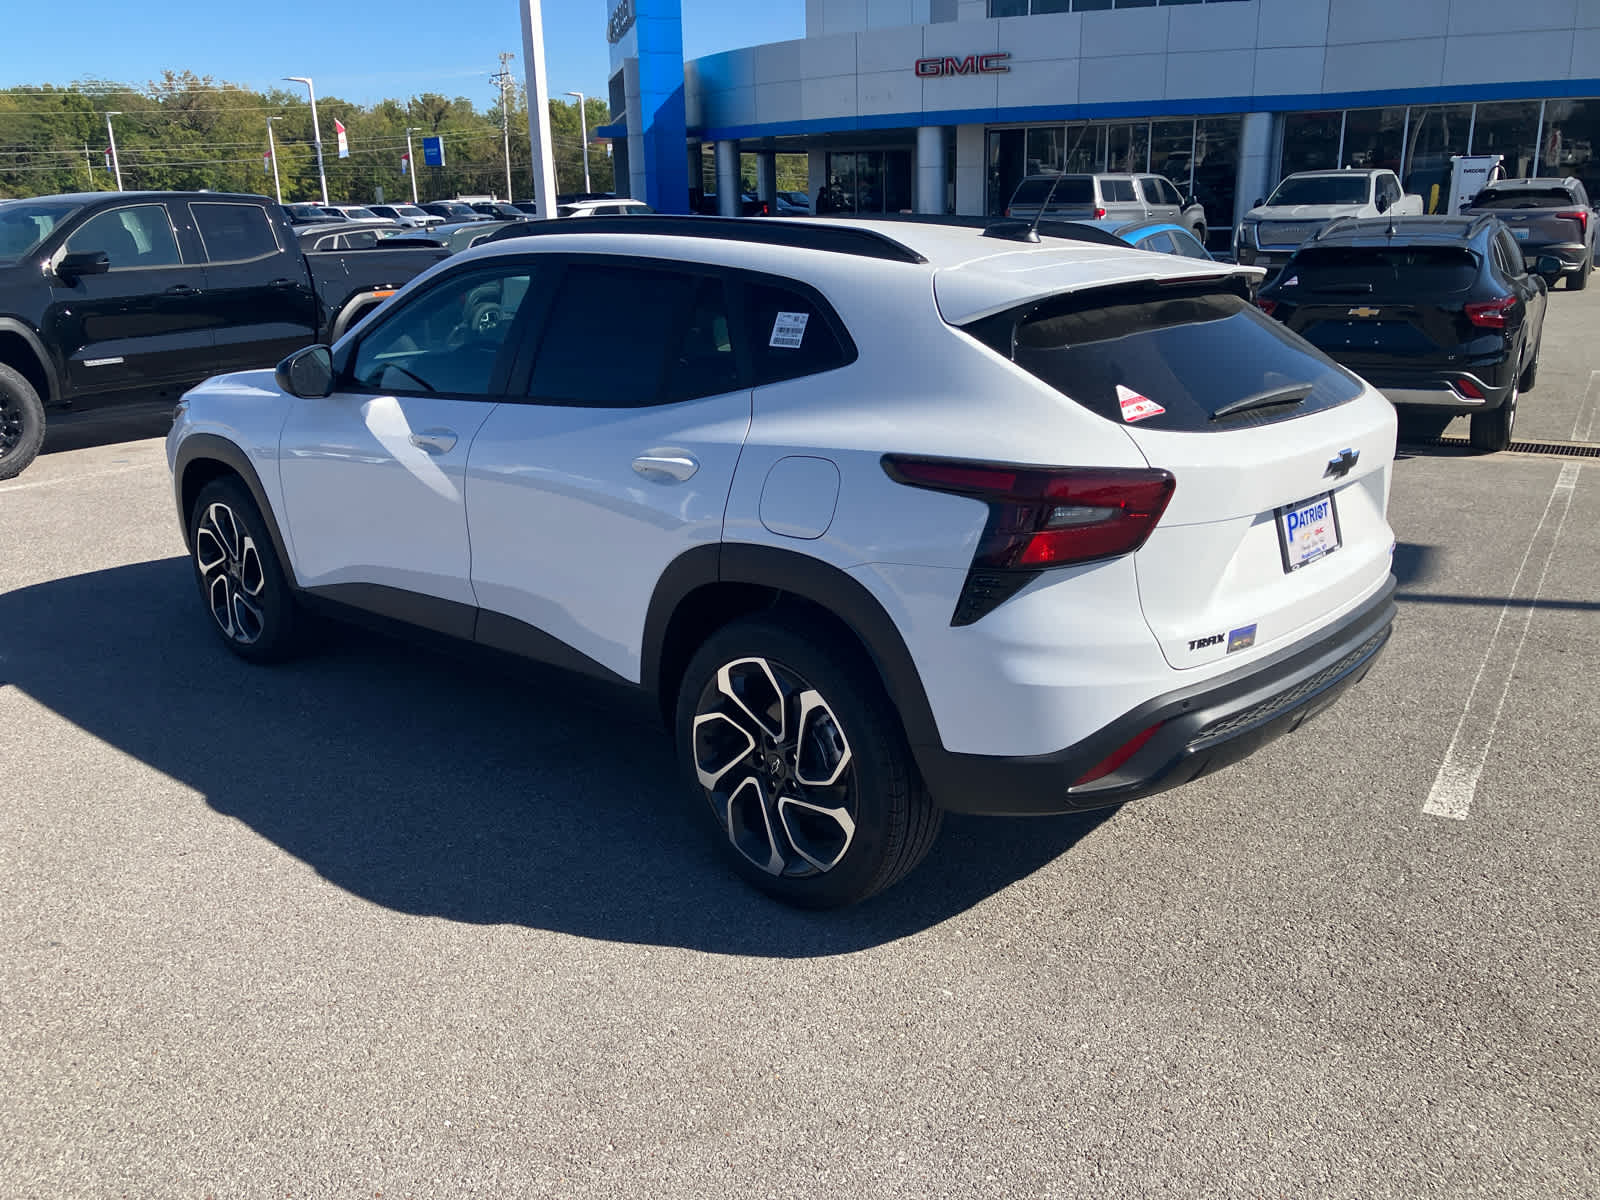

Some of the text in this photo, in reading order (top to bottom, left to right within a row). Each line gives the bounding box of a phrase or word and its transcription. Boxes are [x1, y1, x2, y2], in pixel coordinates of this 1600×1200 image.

[915, 53, 1010, 77] GMC
[1287, 502, 1328, 542] PATRIOT
[1188, 633, 1225, 651] TRAX
